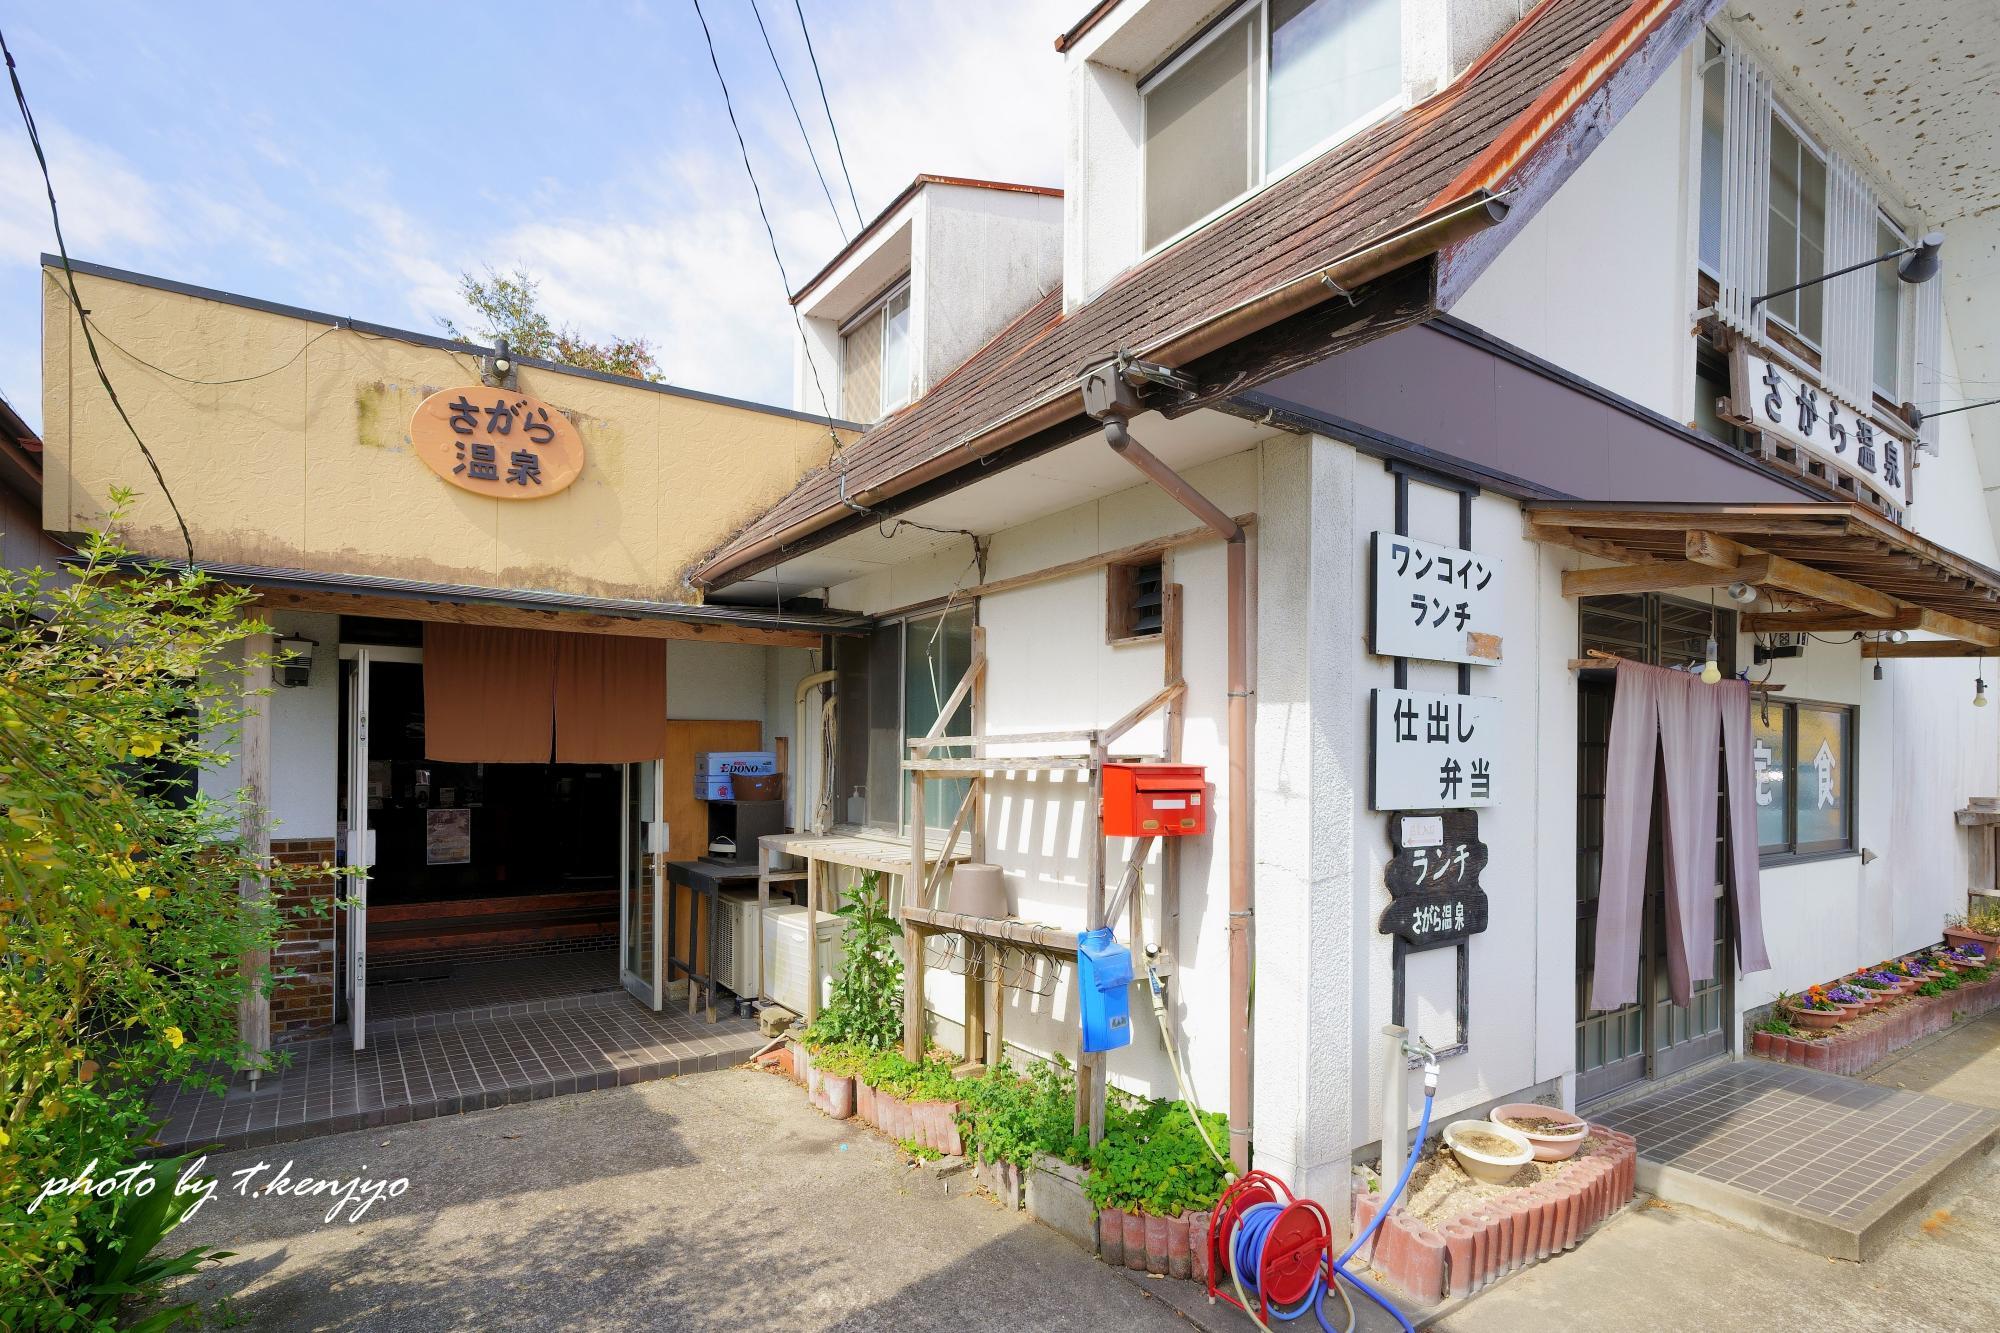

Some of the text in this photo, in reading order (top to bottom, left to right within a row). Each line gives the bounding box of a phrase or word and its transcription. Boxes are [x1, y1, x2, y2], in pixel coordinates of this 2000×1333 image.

[448, 396, 555, 444] さがら
[1763, 364, 1901, 488] さがら温泉
[453, 441, 542, 485] 温泉
[1391, 543, 1492, 591] ワンコイン
[1411, 593, 1471, 632] ランチ
[1393, 698, 1475, 744] 仕出し
[1439, 757, 1490, 800] 弁当
[1412, 844, 1470, 885] ランチ
[1412, 902, 1465, 935] さがら温泉
